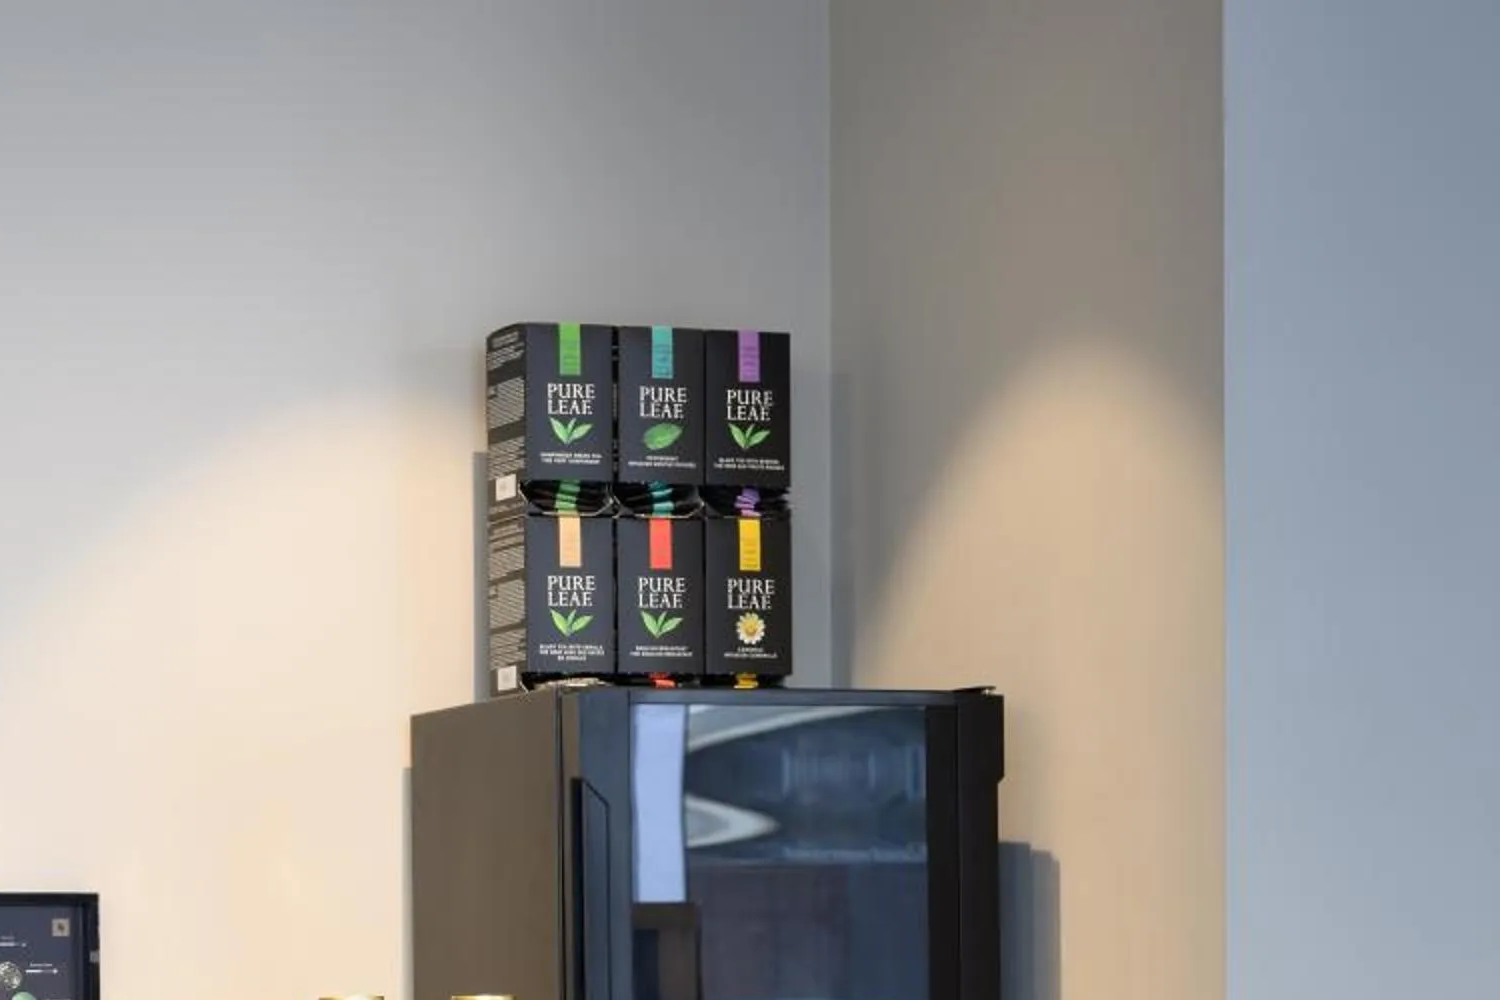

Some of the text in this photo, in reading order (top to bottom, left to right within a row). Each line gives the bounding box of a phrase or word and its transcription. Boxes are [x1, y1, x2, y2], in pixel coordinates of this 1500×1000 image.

[547, 383, 596, 399] PURE
[639, 385, 687, 403] PURE
[727, 389, 774, 407] PURE
[547, 399, 593, 415] LEAF
[640, 402, 684, 419] LEAF
[727, 405, 771, 421] LEAF
[547, 575, 596, 591] PURE
[638, 577, 686, 593] PURE
[727, 578, 775, 595] PURE
[547, 591, 593, 607] LEAF
[638, 592, 683, 609] LEAF
[727, 594, 772, 611] LEAF
